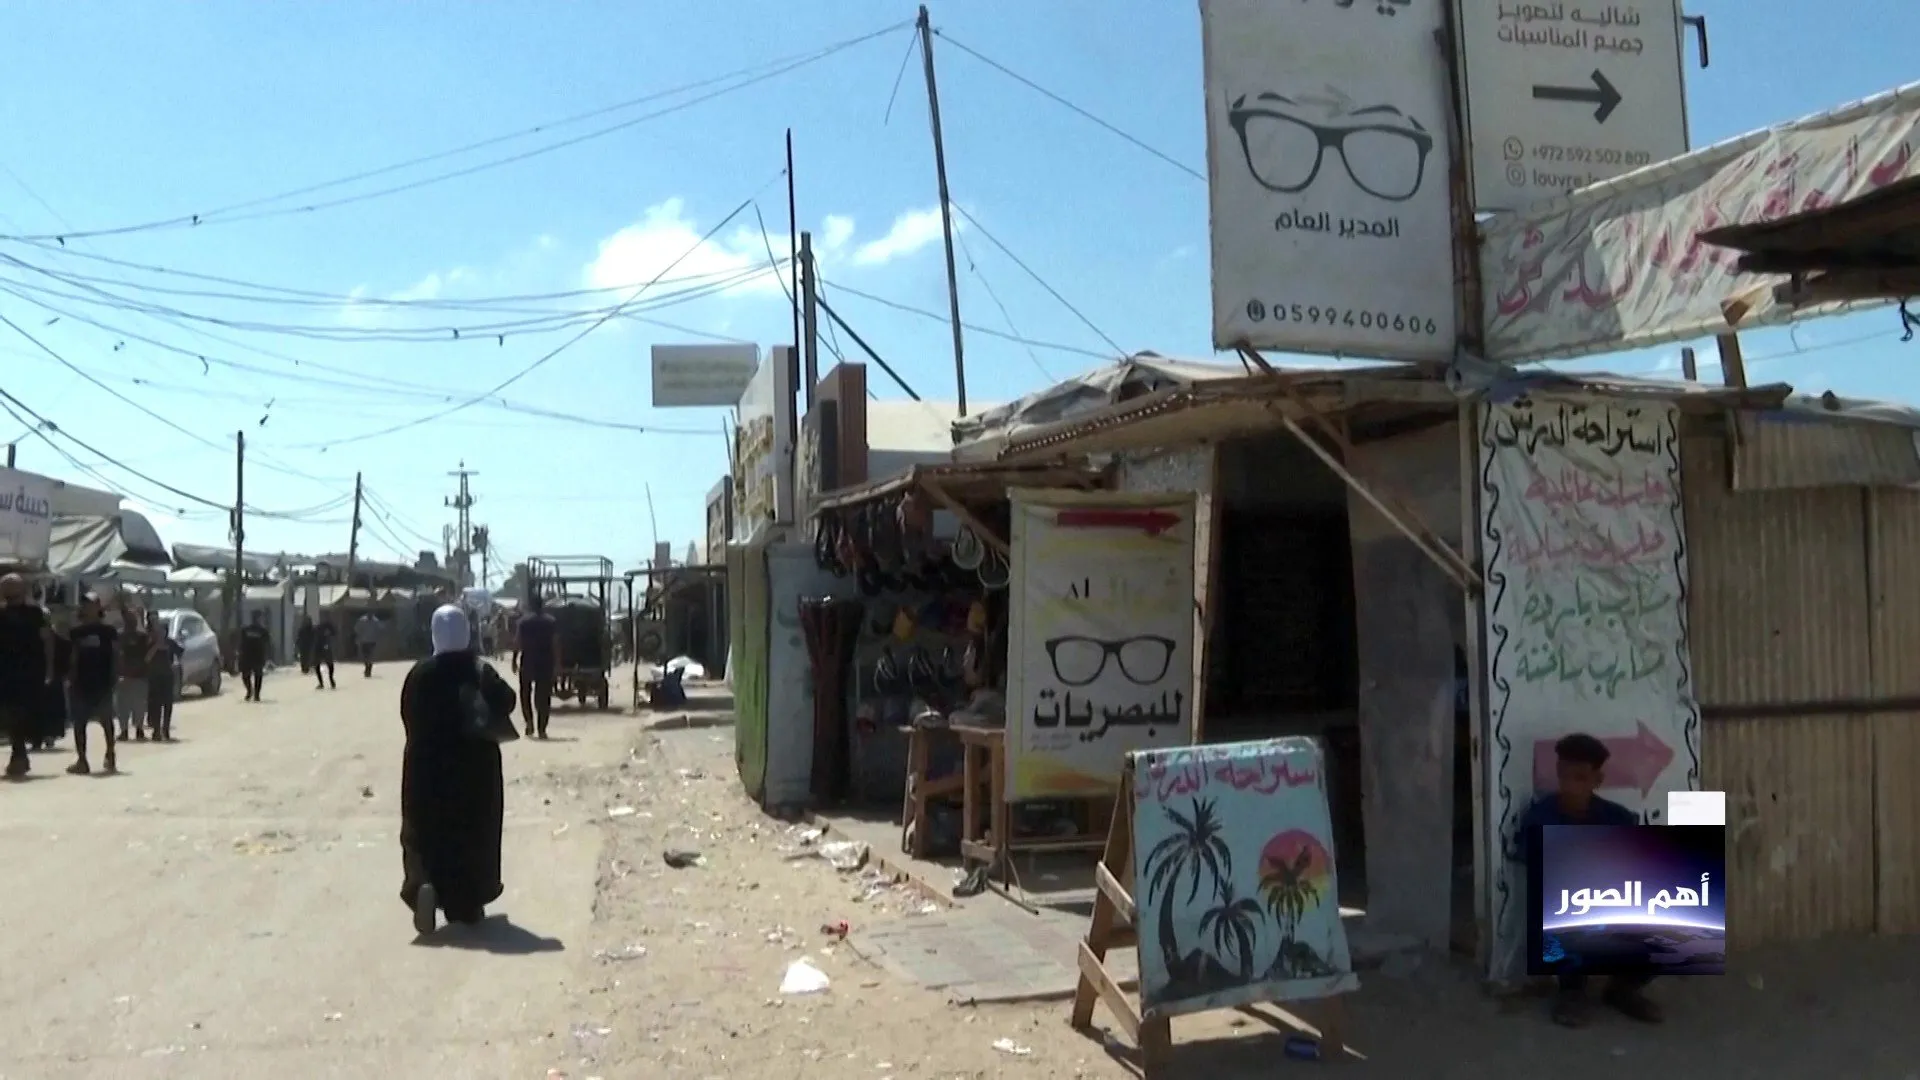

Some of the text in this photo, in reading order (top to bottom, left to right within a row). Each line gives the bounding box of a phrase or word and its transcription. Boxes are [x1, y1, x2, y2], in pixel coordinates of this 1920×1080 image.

[1498, 24, 1587, 50] المناسبات
[1275, 207, 1400, 239] المدير العام
[1273, 303, 1437, 335] 0599400606
[1572, 403, 1661, 457] استراحة
[1034, 689, 1183, 742] للبصريات
